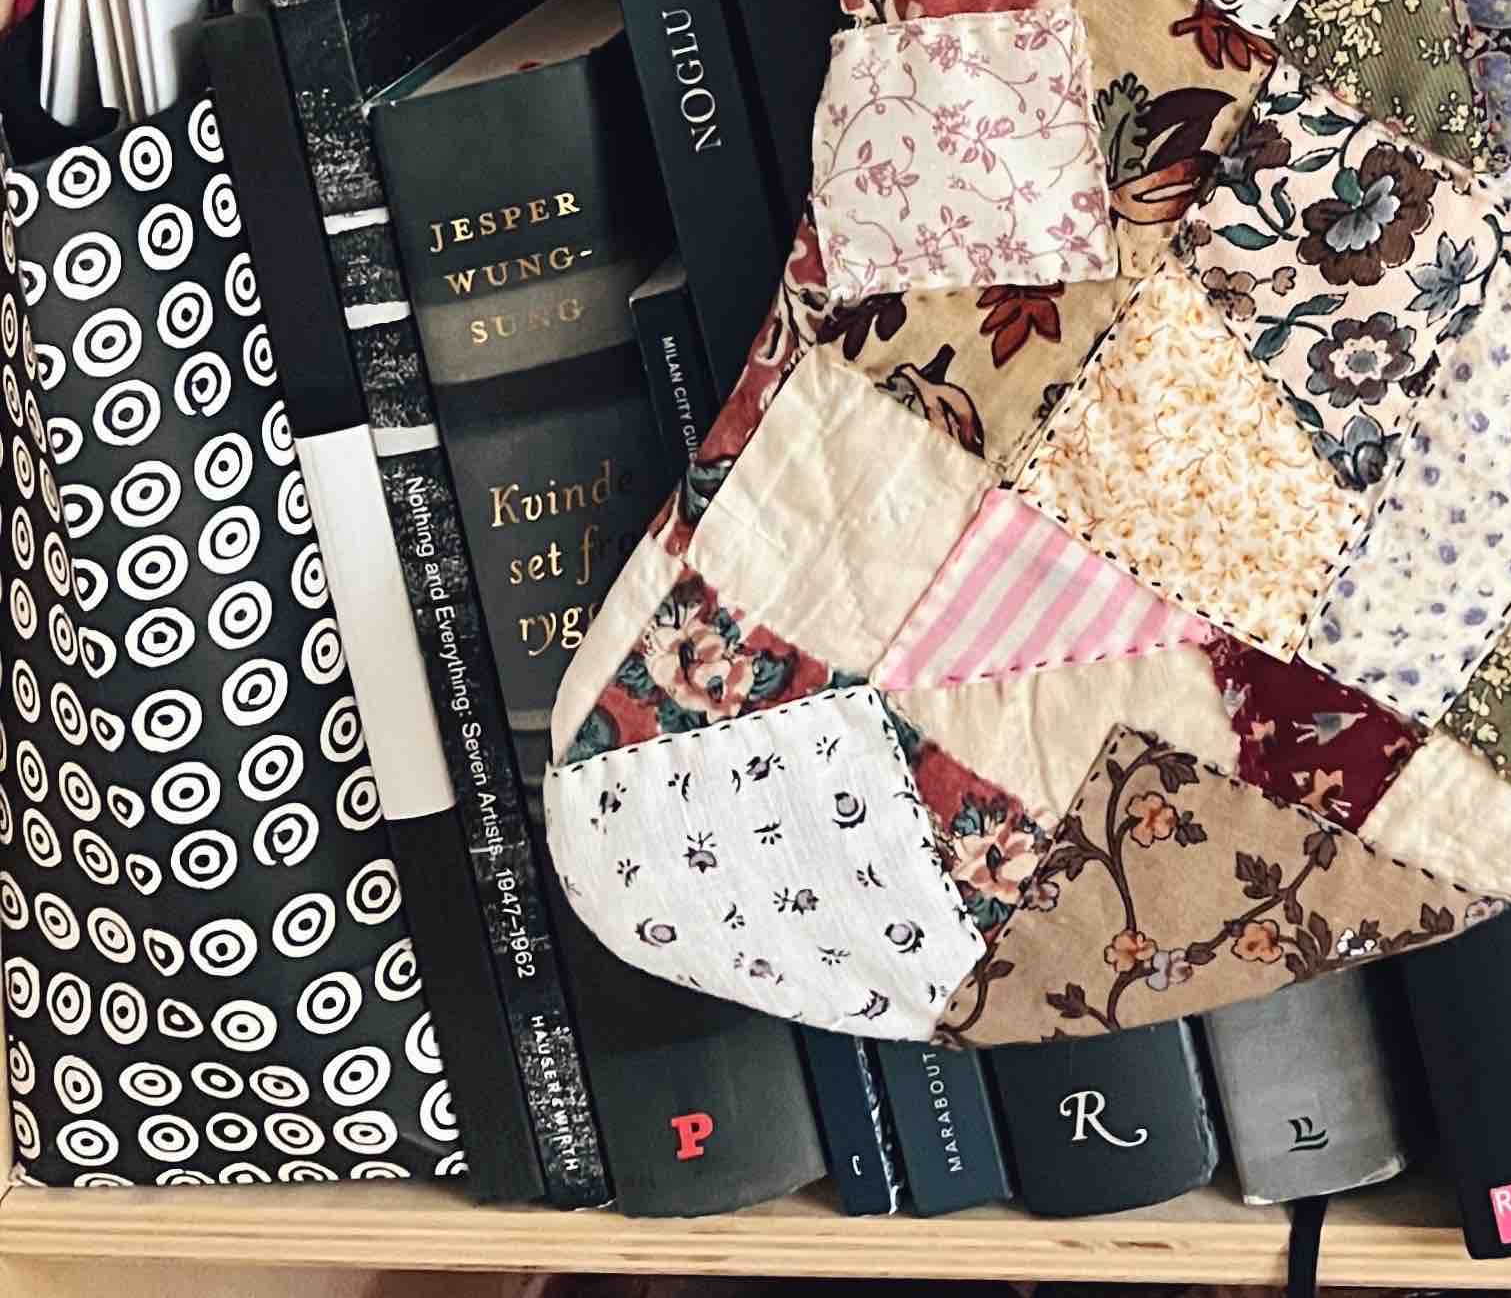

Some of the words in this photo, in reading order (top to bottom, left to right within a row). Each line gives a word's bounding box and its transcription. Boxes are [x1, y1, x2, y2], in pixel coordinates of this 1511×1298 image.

[661, 10, 722, 152] NOGLU
[429, 192, 580, 253] JESPER
[445, 247, 592, 295] WUNG-
[470, 298, 584, 344] SUNG
[661, 337, 683, 384] MILAN
[671, 387, 690, 420] CITY
[405, 476, 437, 557] Nothing
[423, 563, 449, 601] and
[509, 543, 563, 584] set
[433, 605, 474, 717] Everything:
[459, 722, 488, 785] Seven
[478, 793, 504, 862] Artists,
[531, 1016, 560, 1093] HAUSER
[552, 1110, 578, 1171] WIRTH
[922, 1051, 963, 1173] MARABOUT
[1059, 1090, 1147, 1147] R
[671, 1111, 715, 1160] P
